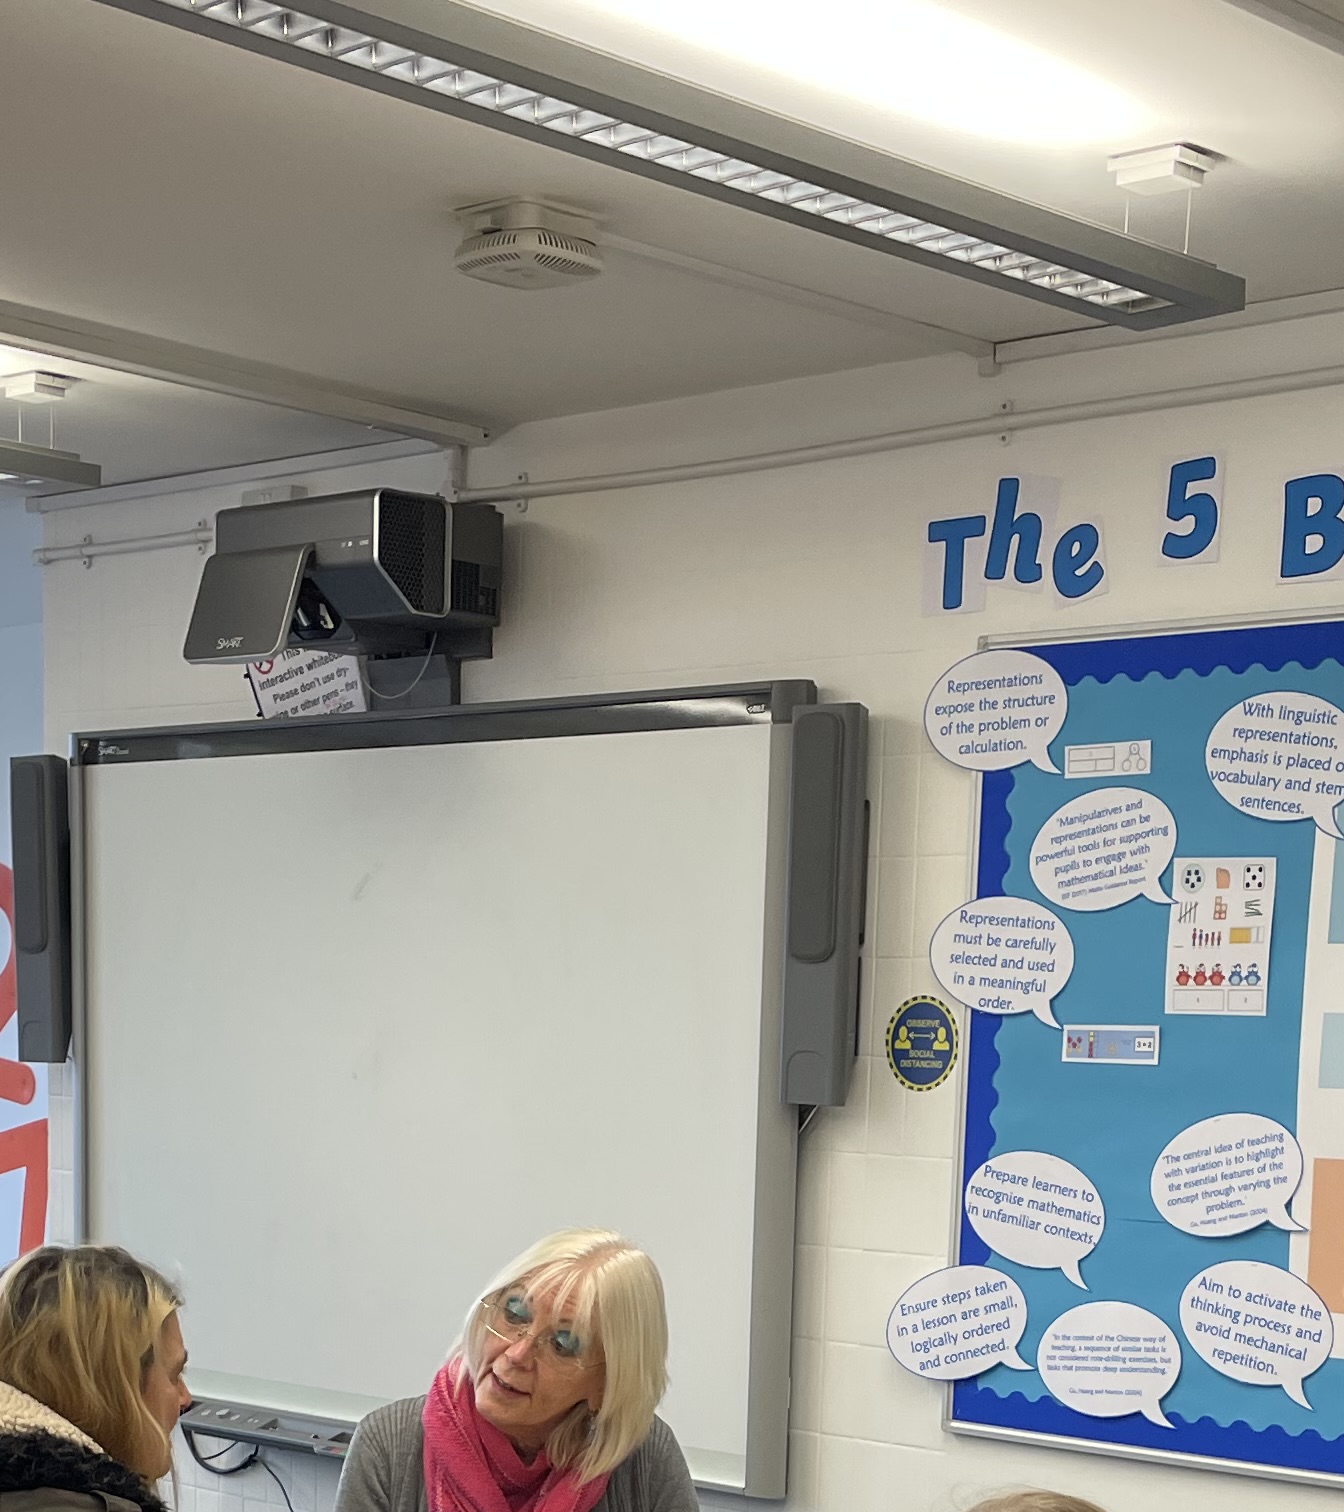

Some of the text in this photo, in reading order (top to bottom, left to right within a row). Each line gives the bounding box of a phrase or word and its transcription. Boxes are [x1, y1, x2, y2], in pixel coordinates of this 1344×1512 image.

[927, 477, 1104, 610] The
[1160, 456, 1221, 561] 5
[258, 665, 304, 691] interactive
[947, 673, 1043, 694] Representations
[273, 688, 299, 704] Please
[935, 694, 1055, 718] expose the structure
[1243, 701, 1338, 725] With linguistic
[940, 716, 1049, 736] of the problem or
[958, 738, 1027, 755] calculation.
[1211, 747, 1269, 764] emphasis
[1273, 751, 1282, 766] is
[1286, 753, 1332, 771] placed
[1210, 770, 1281, 791] vocabulary
[1285, 777, 1312, 792] and
[1240, 796, 1304, 814] sentences.
[984, 1165, 1094, 1202] Prepare learners to
[968, 1202, 978, 1215] in
[983, 1209, 1041, 1231] unfamiliar
[970, 1185, 1101, 1225] recognise mathematics
[1198, 1276, 1321, 1320] Aim to activate the
[1191, 1296, 1322, 1343] thinking process and
[1196, 1321, 1307, 1361] avoid mechanical
[1212, 1347, 1278, 1375] repetition.
